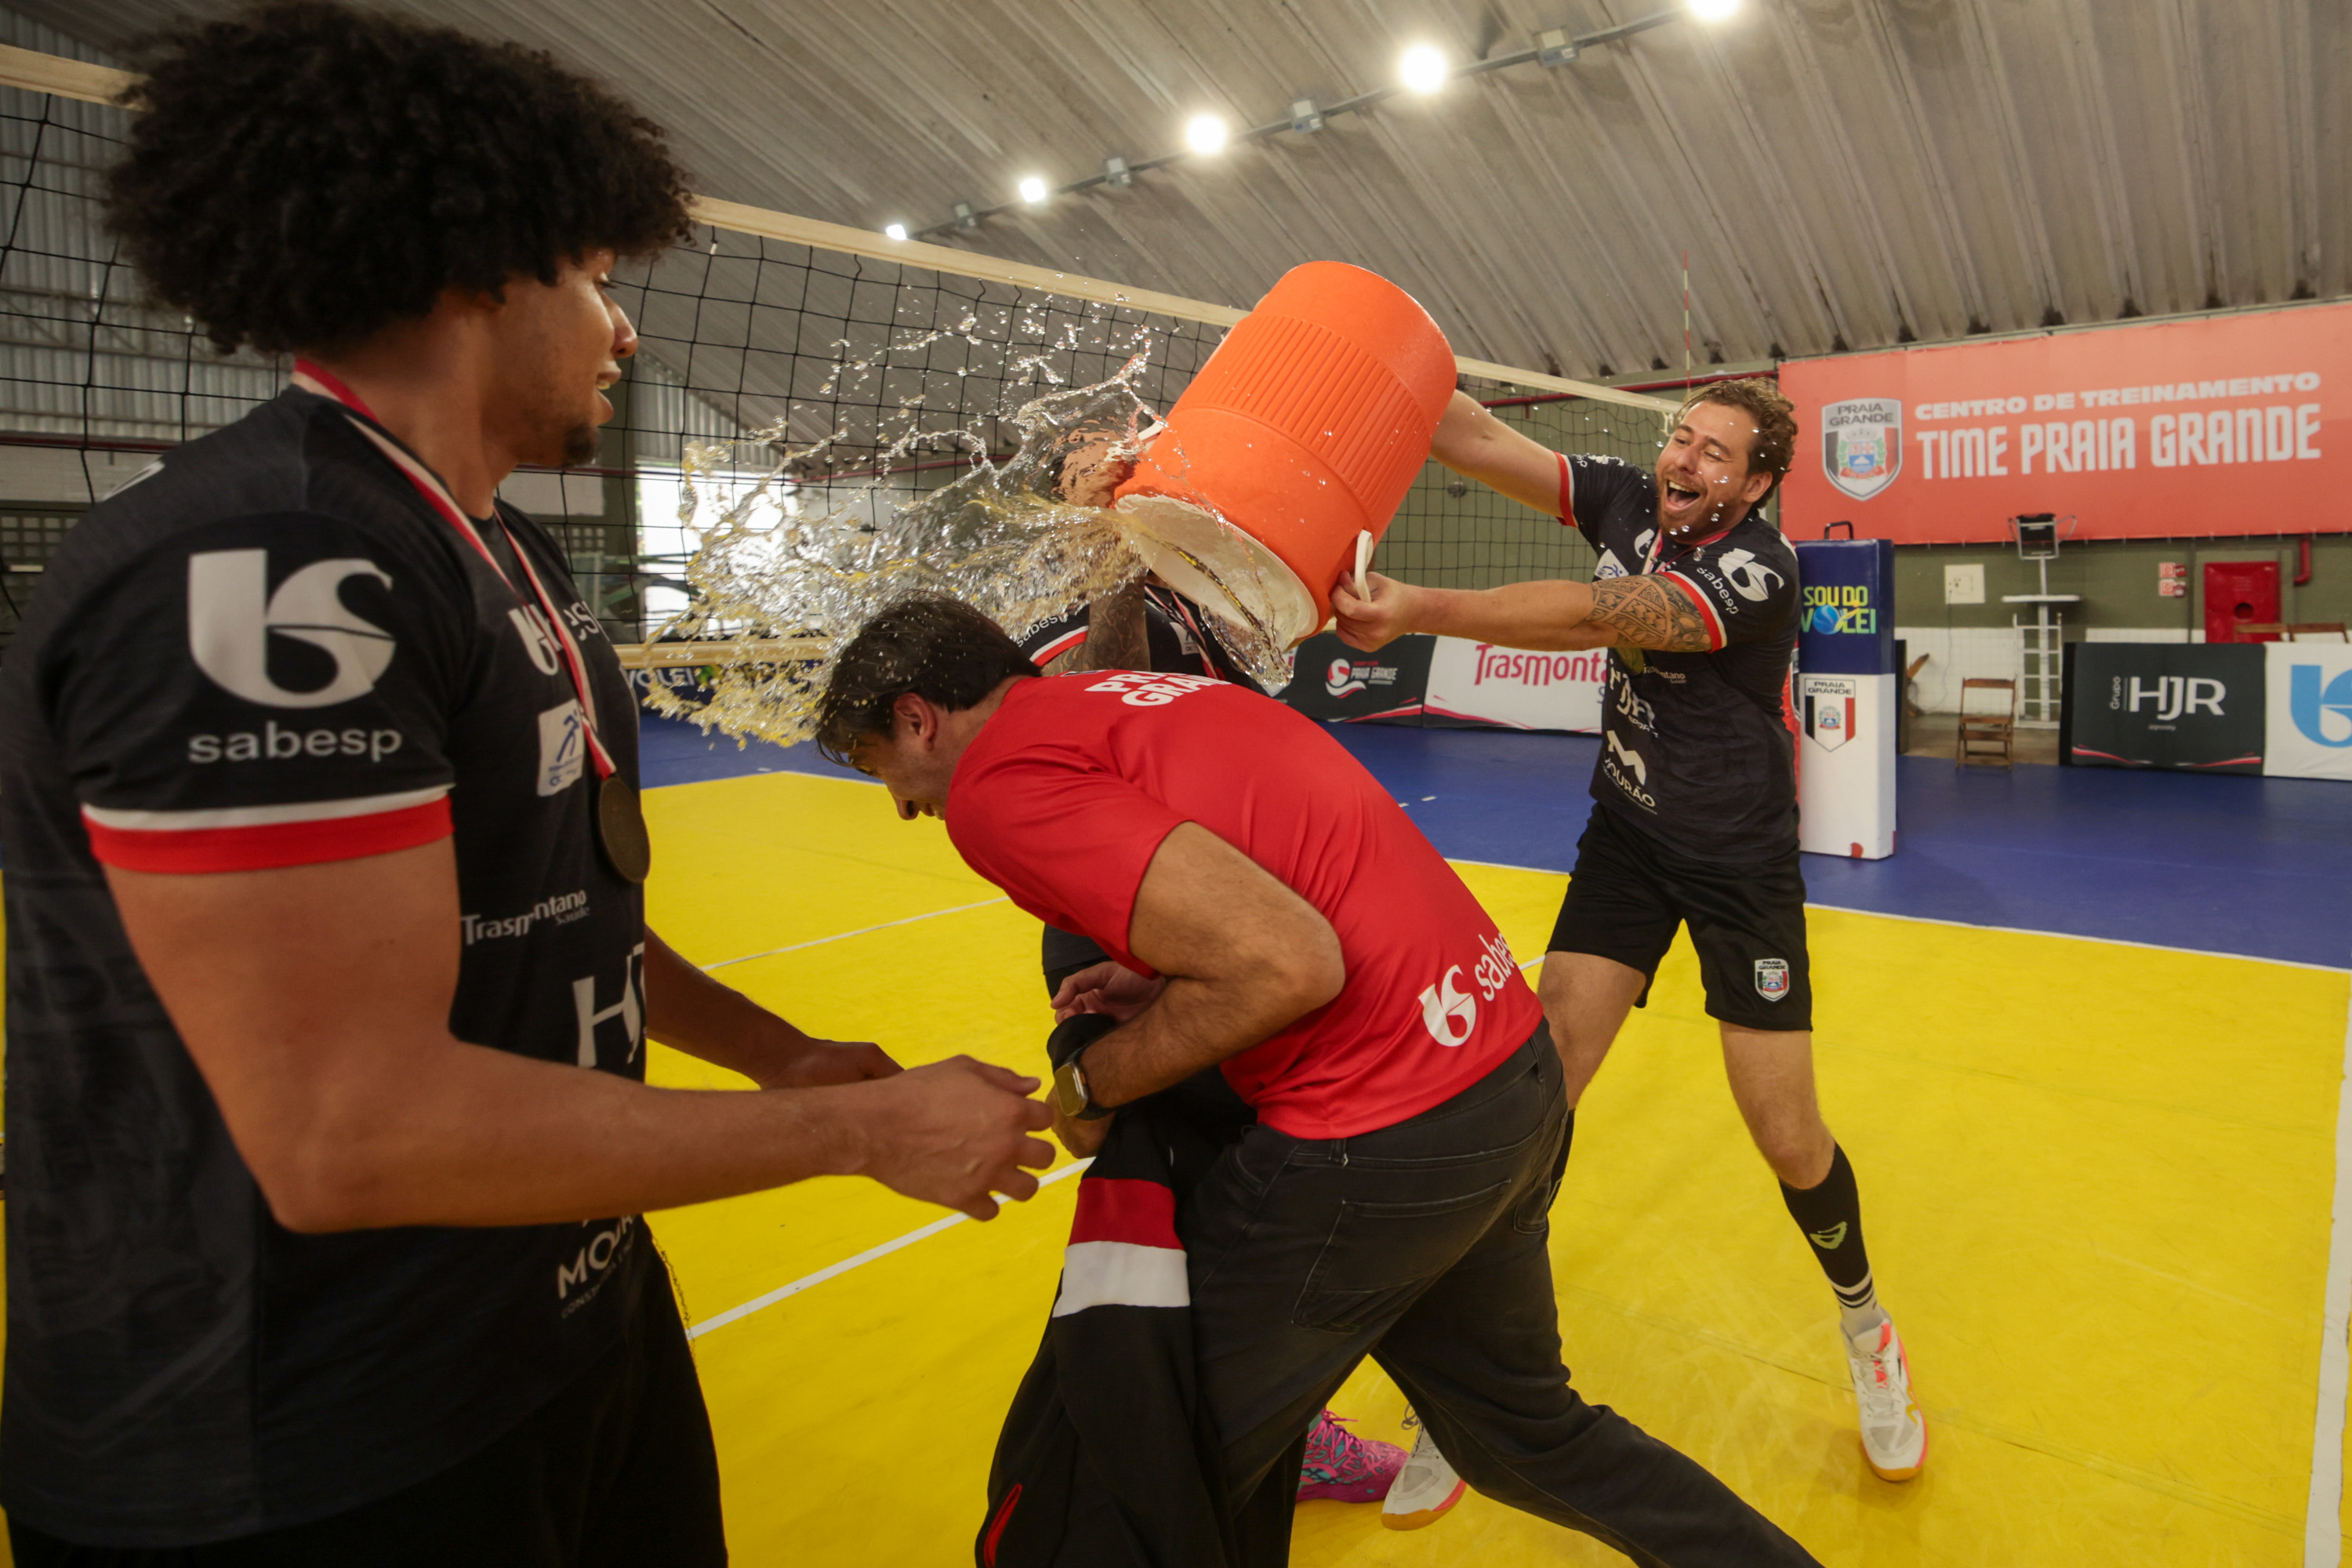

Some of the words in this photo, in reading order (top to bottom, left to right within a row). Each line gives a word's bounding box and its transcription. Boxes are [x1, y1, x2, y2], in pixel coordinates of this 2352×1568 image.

[1838, 403, 1883, 415] PRAIA
[1915, 396, 2027, 420] CENTRO
[2034, 393, 2075, 412] DE
[2080, 372, 2321, 408] TREINAMENTO
[1829, 412, 1893, 426] GRANDE
[1915, 426, 2009, 479] TIME
[2020, 417, 2136, 474] PRAIA
[2151, 403, 2321, 468] GRANDE
[1696, 566, 1740, 615] sabesp
[1803, 586, 1839, 606] SOU
[1842, 586, 1869, 607] DO
[2110, 676, 2122, 710] Grupo
[2129, 676, 2226, 720] HJR
[188, 720, 402, 763] sabesp
